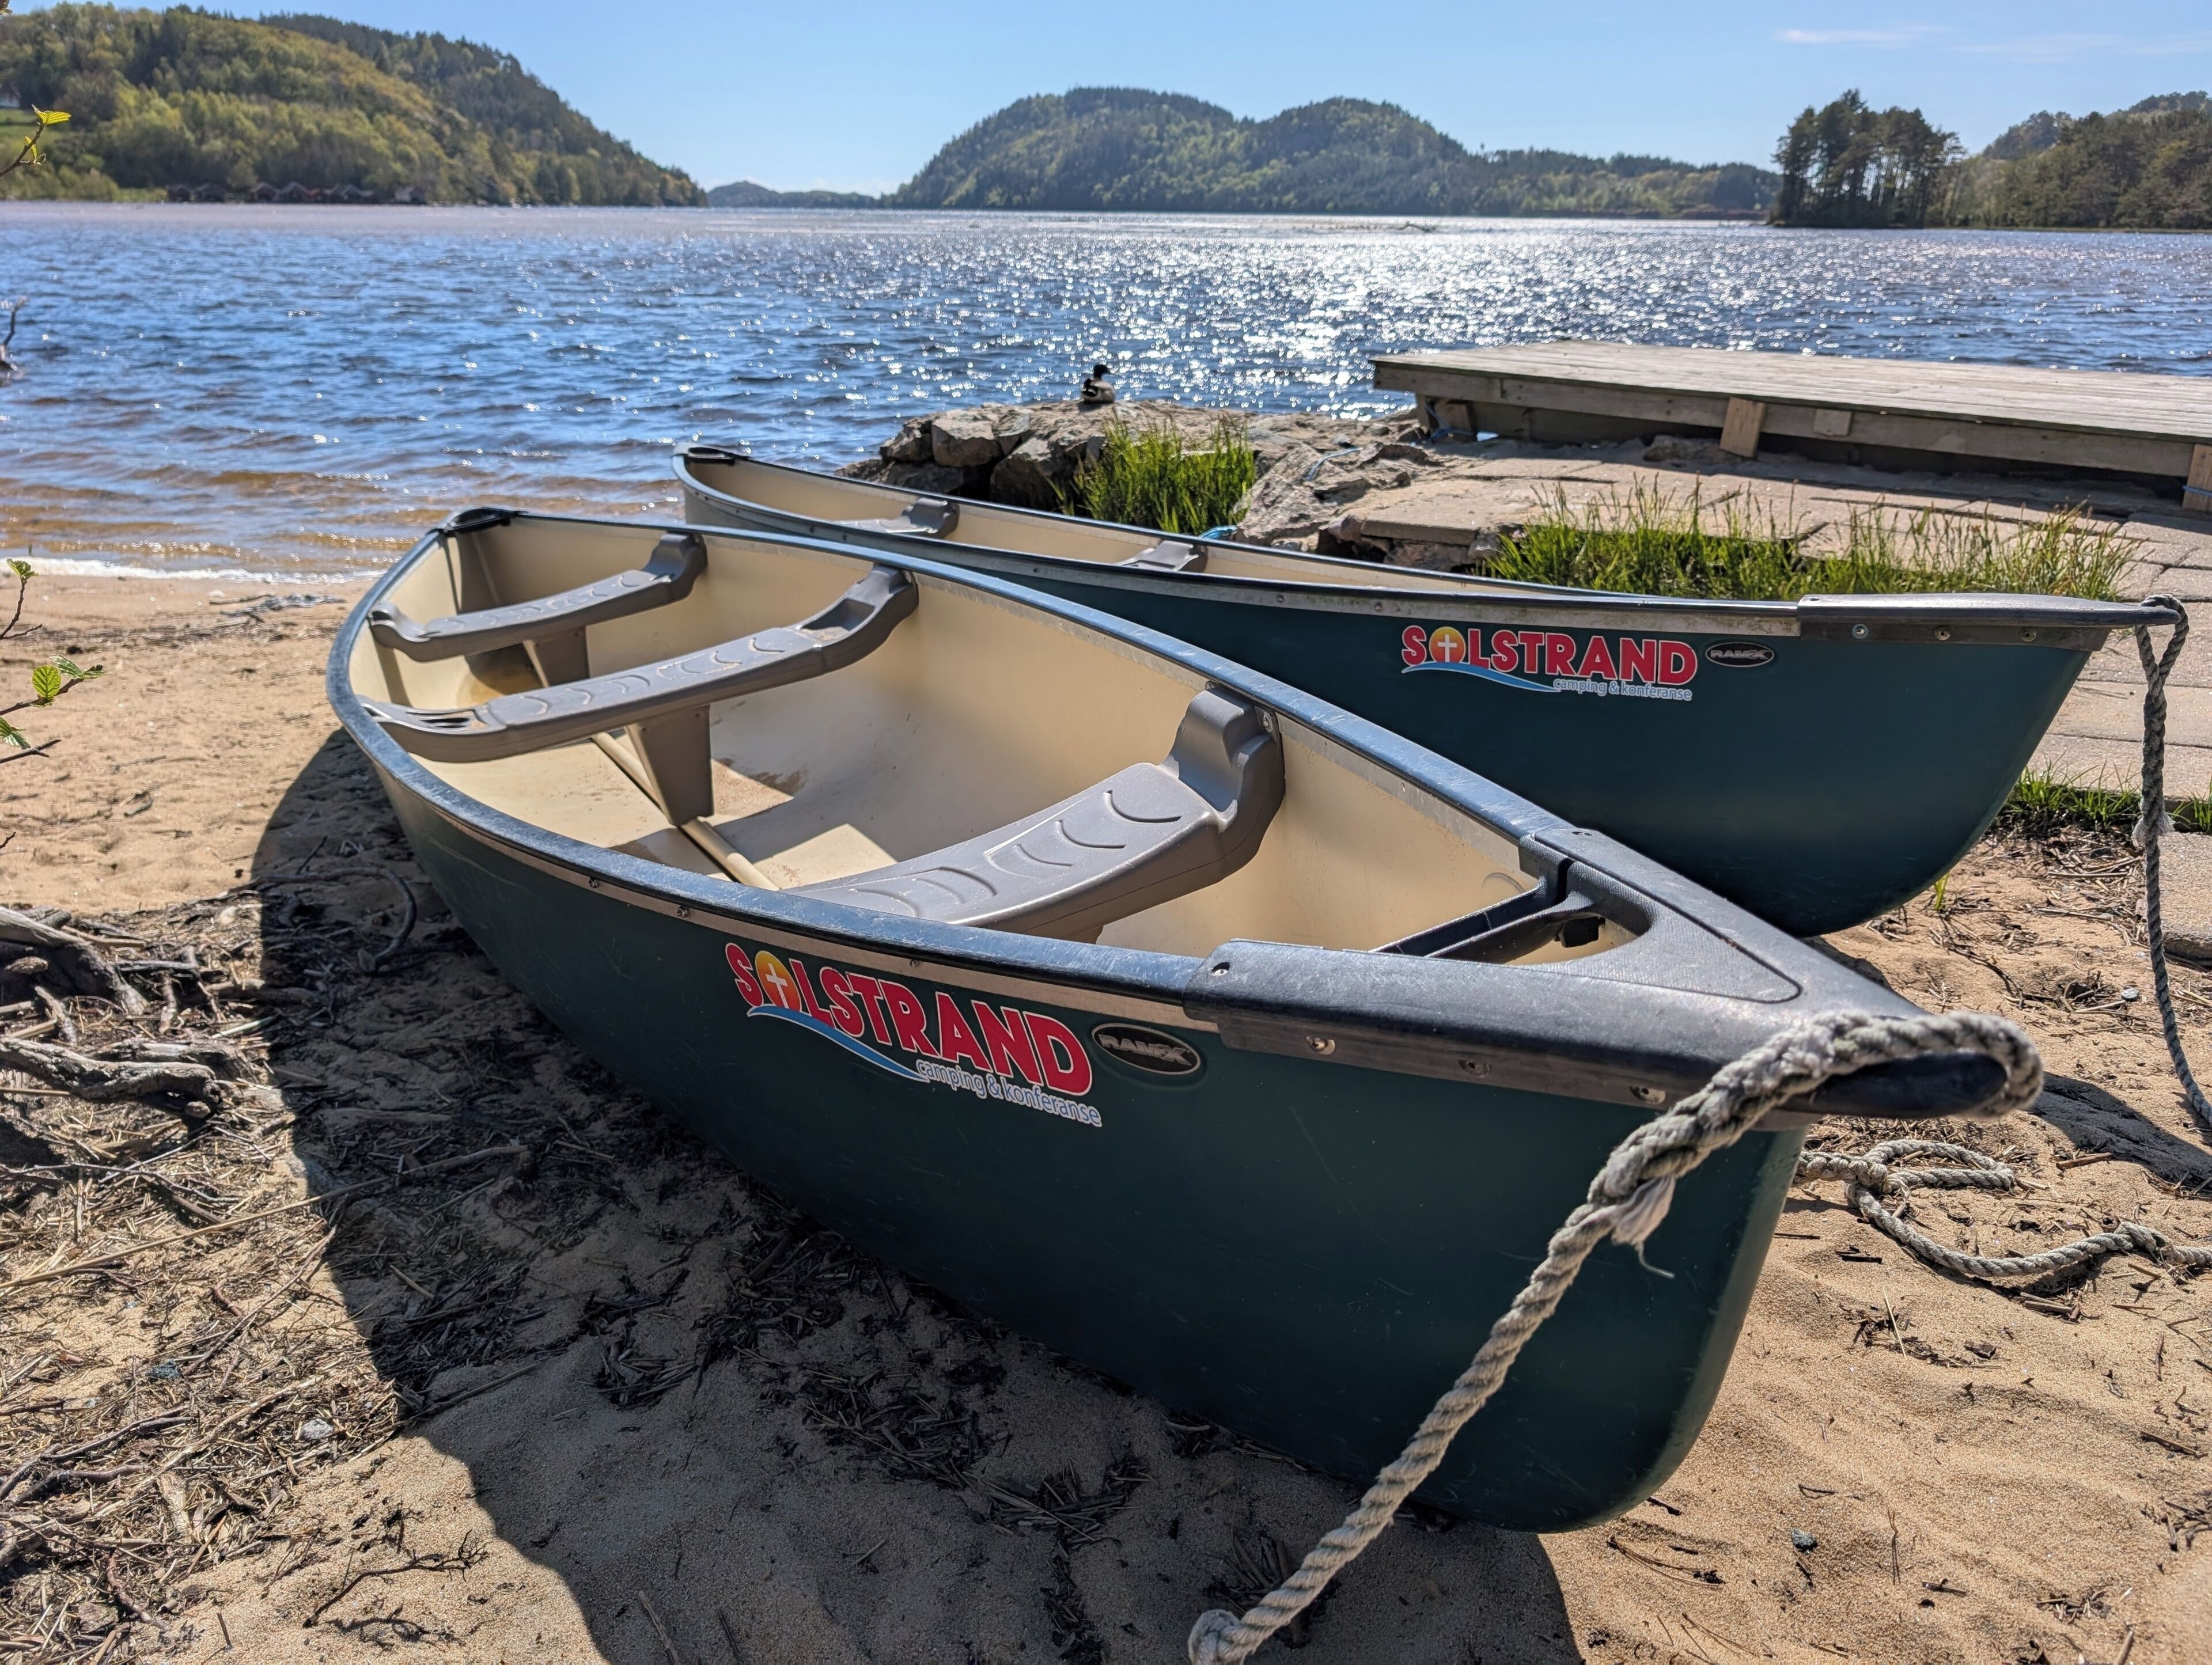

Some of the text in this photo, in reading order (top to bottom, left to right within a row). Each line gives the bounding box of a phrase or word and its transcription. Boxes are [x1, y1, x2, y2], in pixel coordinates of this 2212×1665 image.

[1554, 679, 1692, 701] camping & konferanse
[916, 1060, 1102, 1127] camping & konferanse
